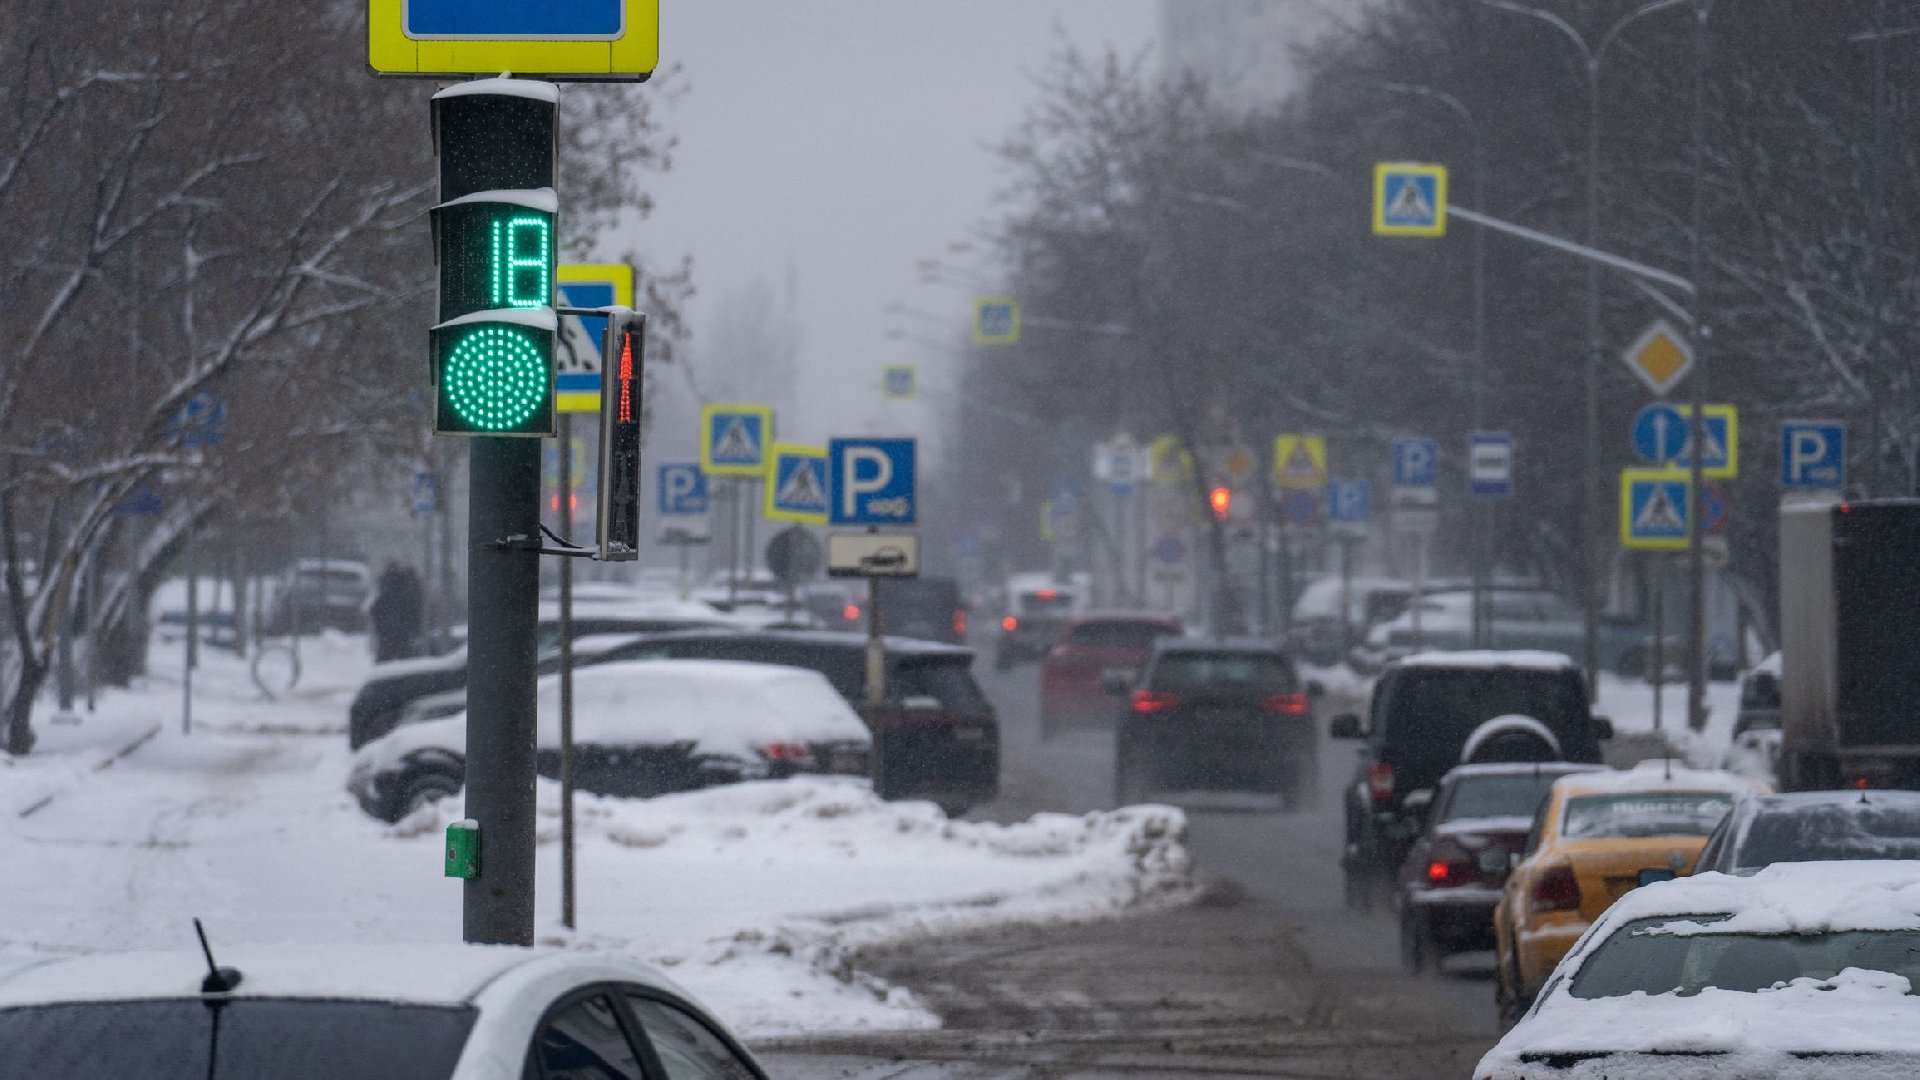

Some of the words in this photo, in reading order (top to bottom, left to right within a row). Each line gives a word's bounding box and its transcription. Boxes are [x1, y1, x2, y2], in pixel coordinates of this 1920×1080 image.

[493, 218, 548, 307] 18
[1402, 444, 1429, 480] P
[1791, 432, 1826, 480] P
[666, 468, 695, 508] P
[842, 447, 893, 517] P
